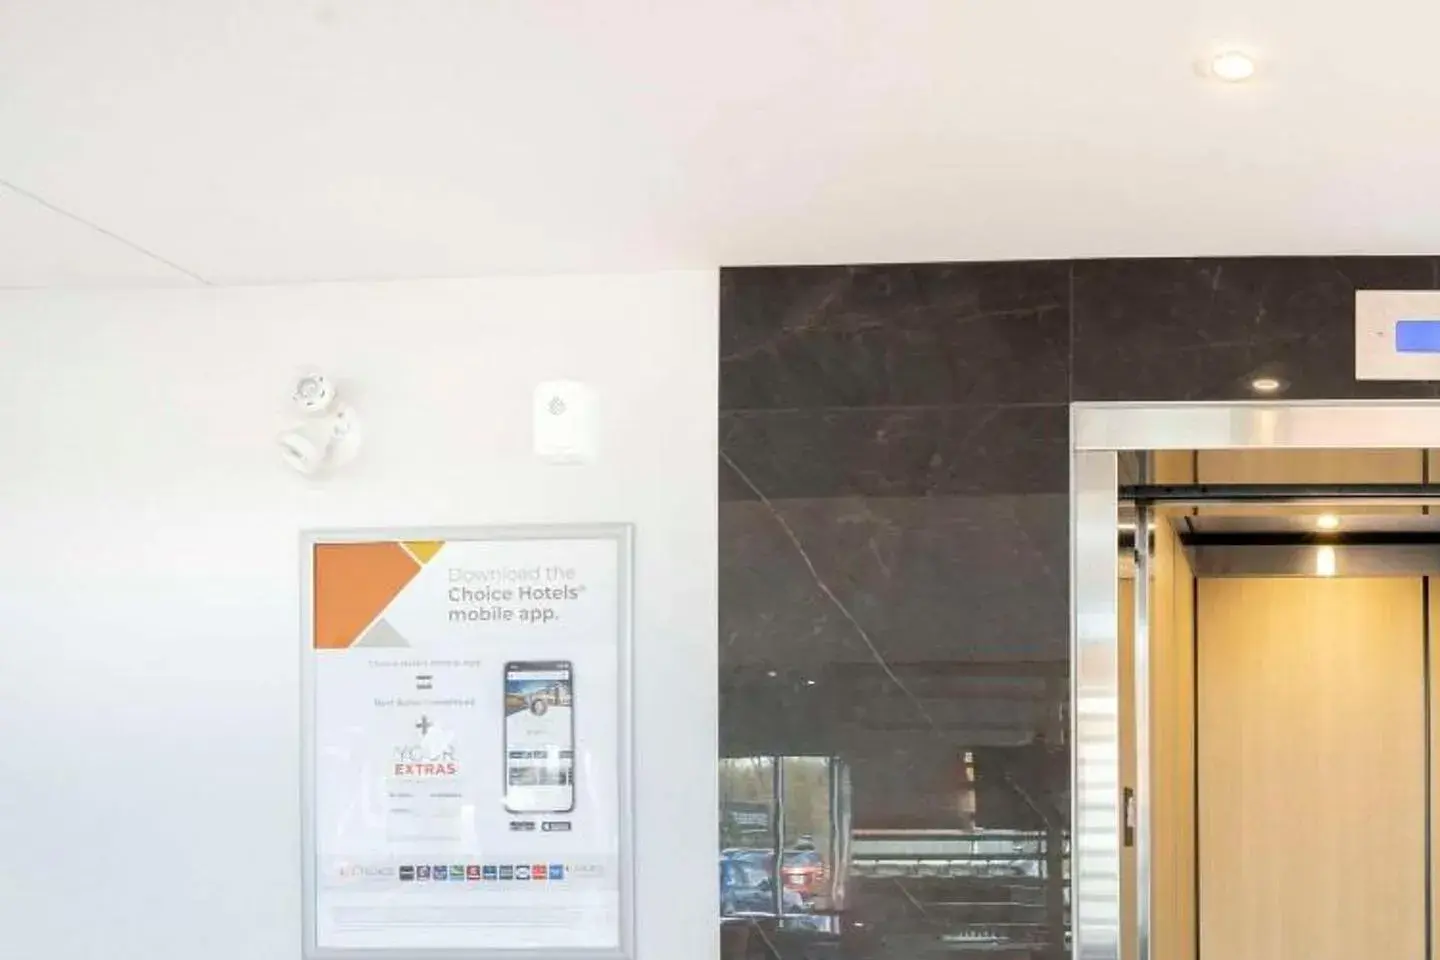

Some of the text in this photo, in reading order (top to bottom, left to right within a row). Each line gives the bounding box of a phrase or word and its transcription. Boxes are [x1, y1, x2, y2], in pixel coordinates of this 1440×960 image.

[448, 565, 576, 582] Download the
[448, 585, 513, 602] Choice
[448, 606, 559, 623] mobile app.
[394, 763, 457, 775] EXTRAS
